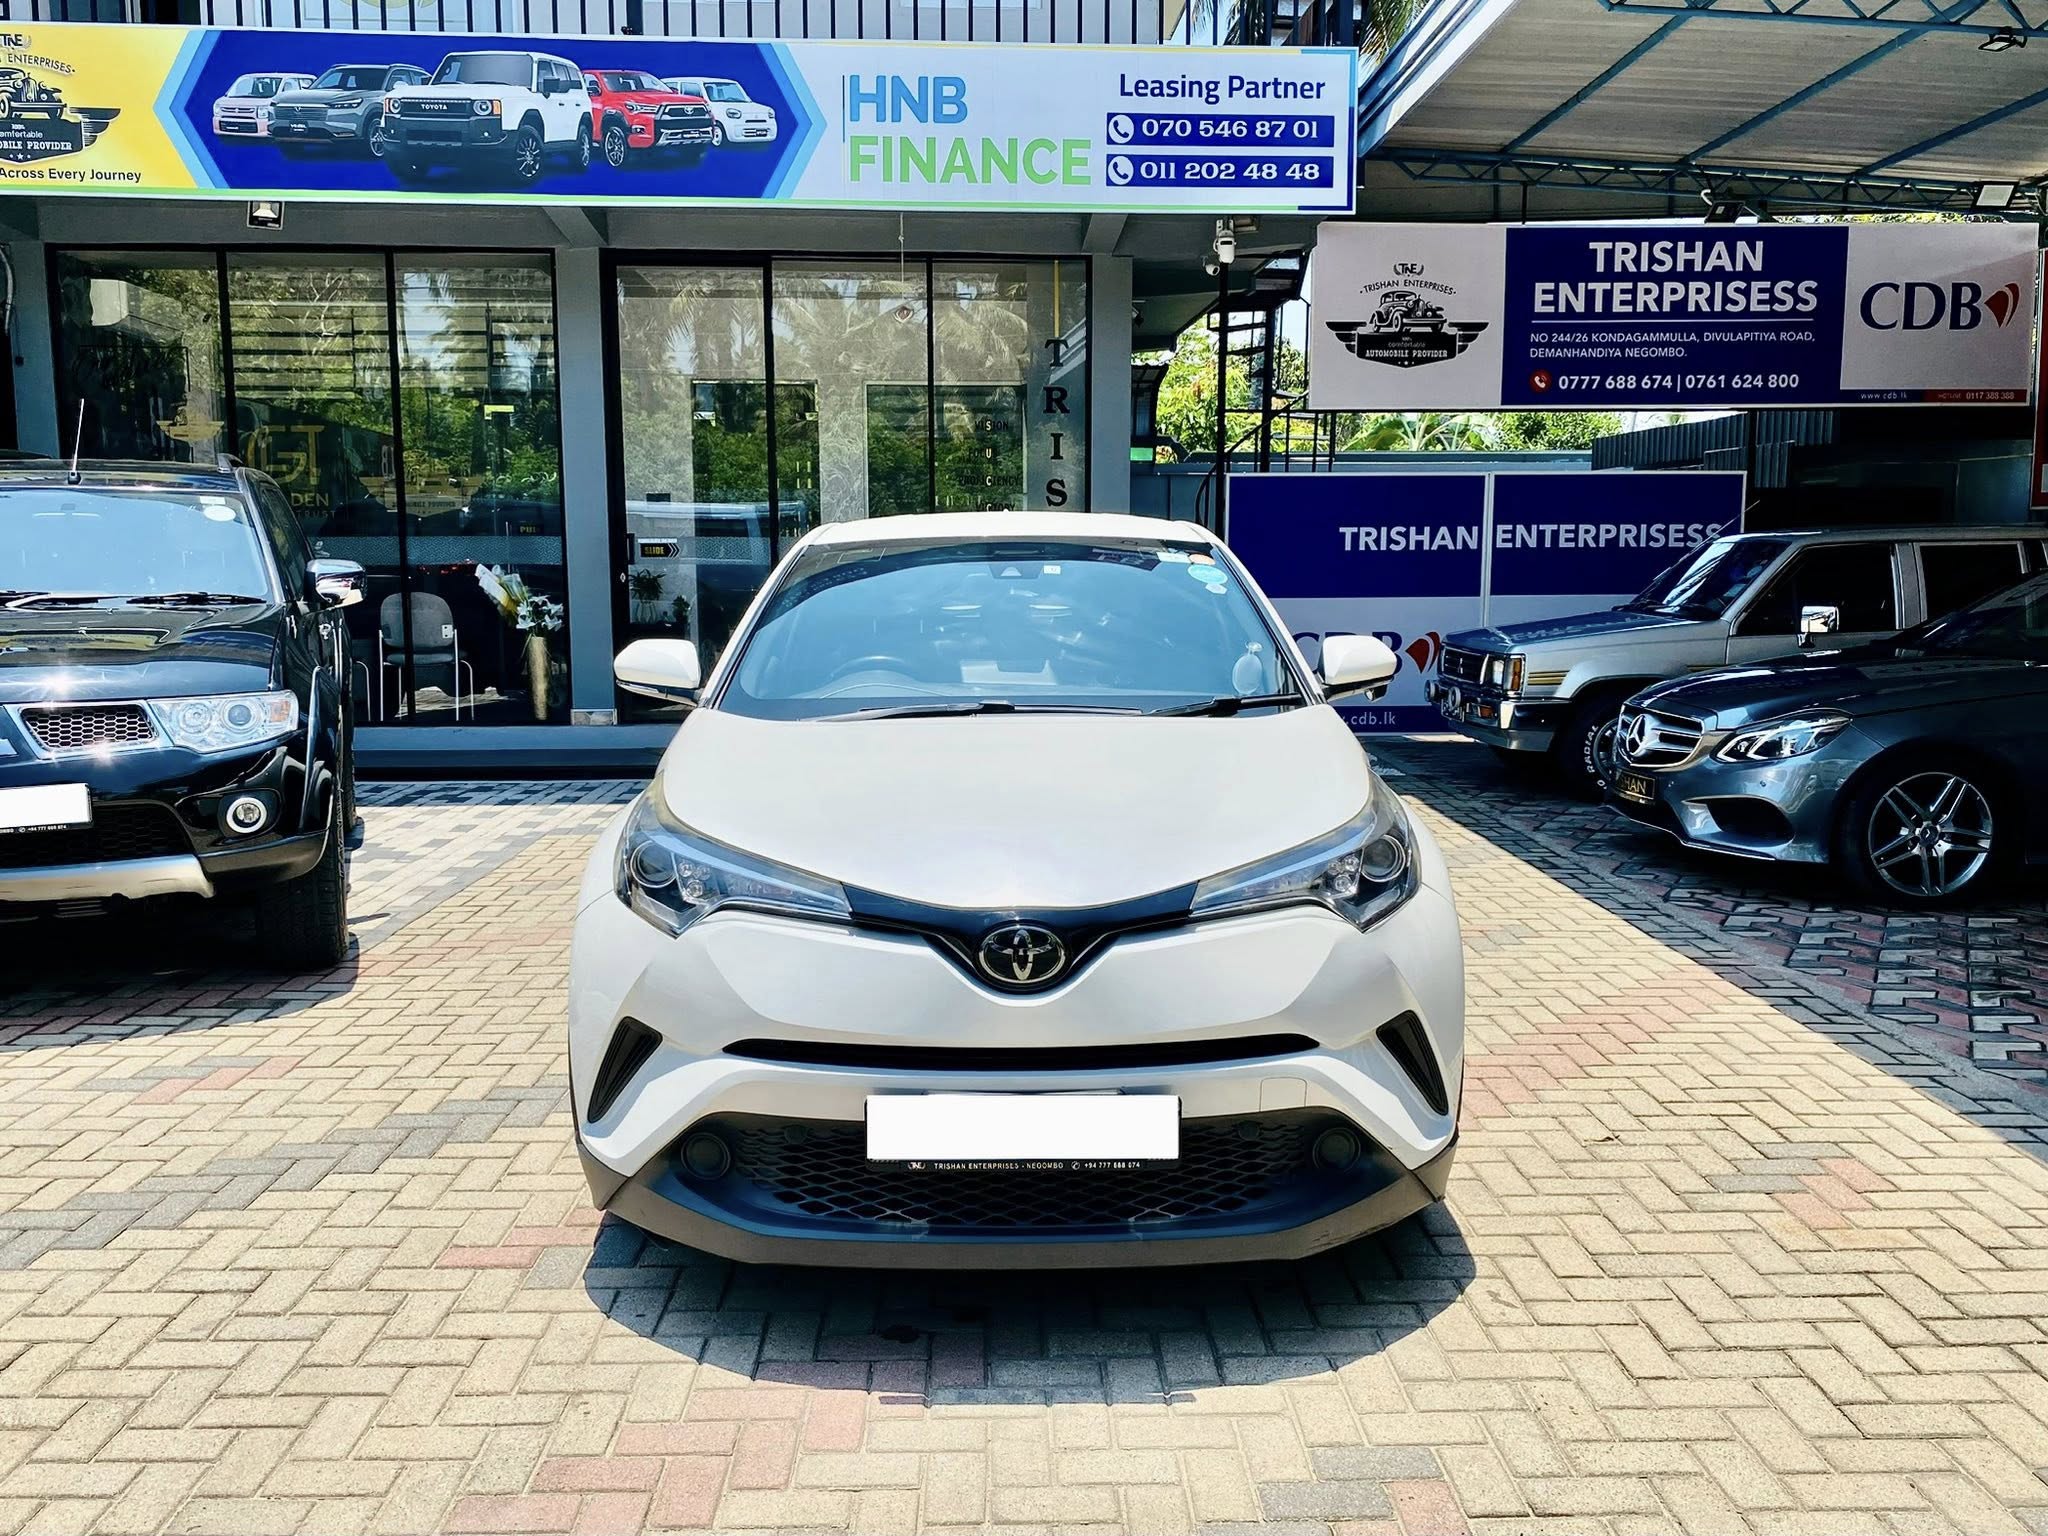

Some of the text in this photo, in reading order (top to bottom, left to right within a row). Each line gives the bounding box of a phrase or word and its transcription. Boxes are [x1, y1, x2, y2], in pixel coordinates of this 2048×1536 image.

[8, 53, 72, 74] ENTERPRISES
[849, 74, 968, 124] HNB
[1119, 73, 1326, 105] Leasing Partner
[1141, 119, 1319, 140] 070 546 87 01
[26, 141, 73, 151] PROVIDER
[849, 135, 1092, 187] FINANCE
[1140, 161, 1320, 182] 011 202 48 48
[0, 167, 142, 183] Across Every Journey
[1589, 240, 1764, 273] TRISHAN
[1363, 279, 1453, 296] TRISHAN ENTERPRISES
[1534, 280, 1818, 313] ENTERPRISESS
[1859, 281, 1983, 331] CDB
[1530, 332, 1549, 343] NO
[1551, 332, 1589, 343] 244/26
[1591, 332, 1700, 344] KONDAGAMMULLA,
[1703, 331, 1777, 342] DIVULAPITIYA
[1365, 349, 1448, 358] AUTOMOBILE PROVIDER
[1530, 346, 1688, 358] DEMANHANDIYA NEGOMBO.
[1558, 373, 1799, 389] 0777 688 674 0761 624 800
[1966, 392, 1984, 400] 0117
[1339, 522, 1722, 552] TRISHAN ENTERPRISESS
[644, 546, 665, 555] SLIDE
[1583, 724, 1599, 774] RADIAL
[934, 1162, 966, 1170] TRISHAN
[968, 1162, 1019, 1170] ENTERPRISES
